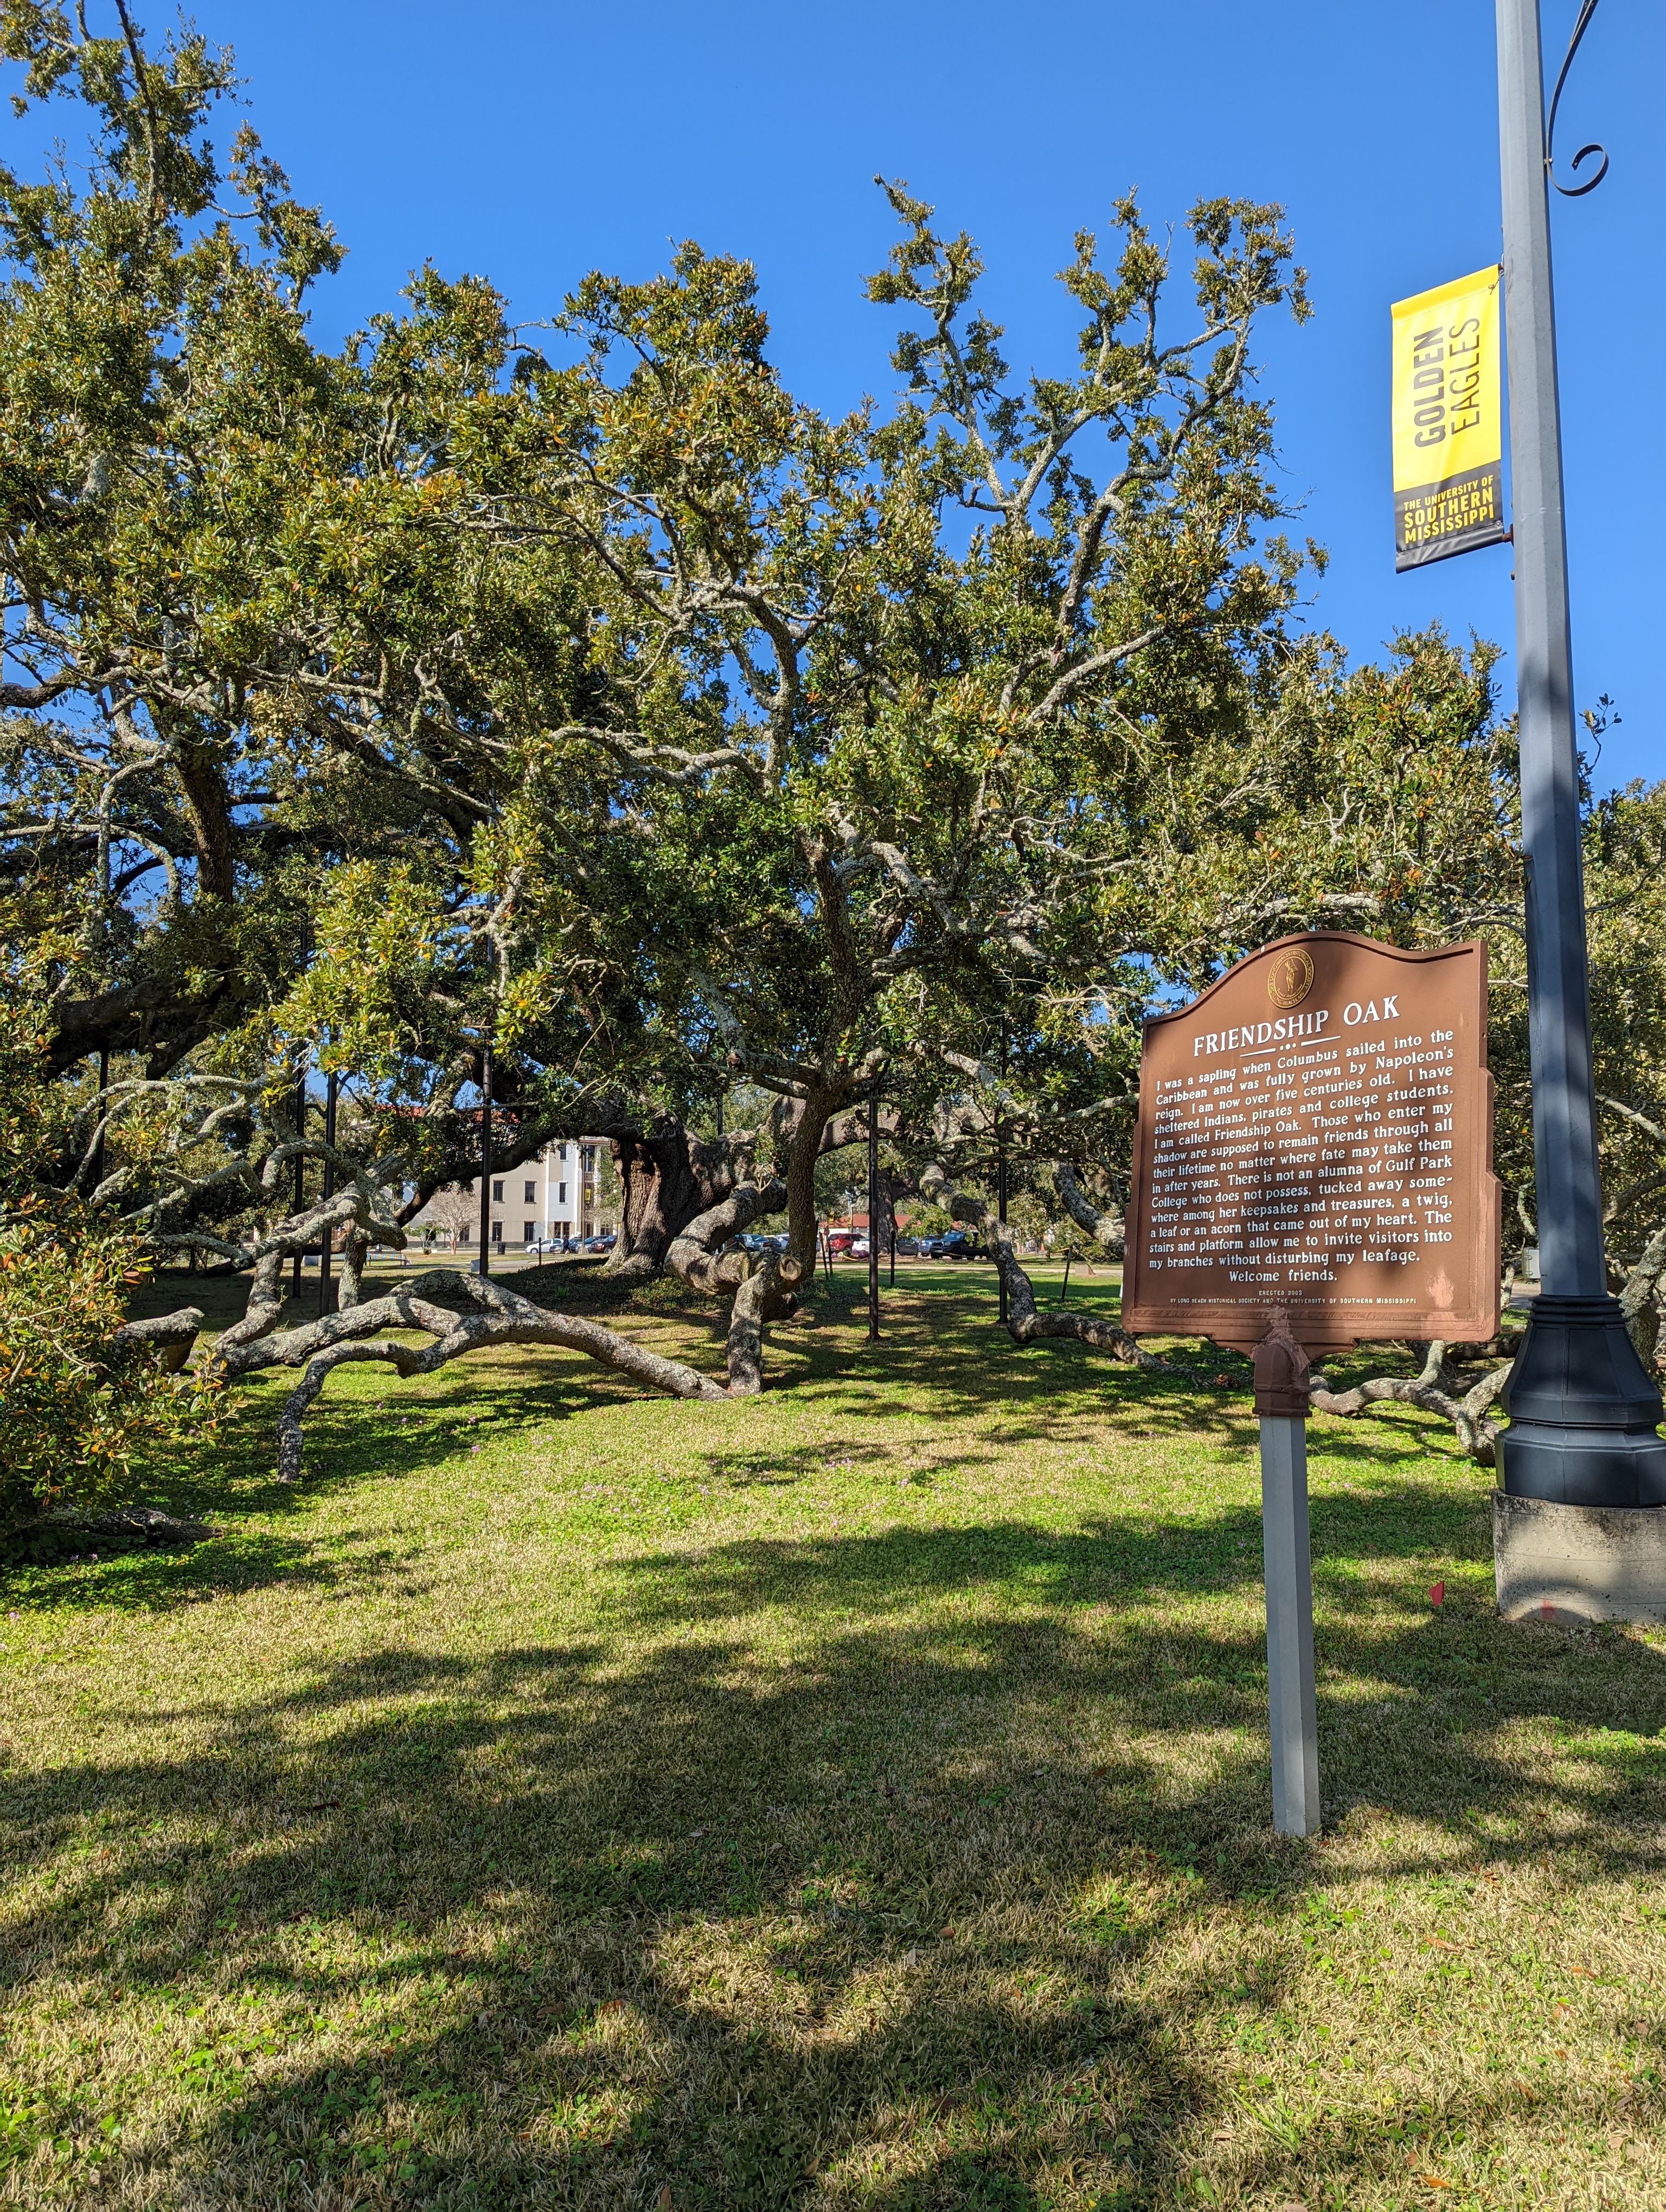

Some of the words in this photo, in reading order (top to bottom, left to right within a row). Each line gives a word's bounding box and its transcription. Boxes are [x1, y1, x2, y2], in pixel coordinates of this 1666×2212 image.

[1413, 326, 1446, 447] GOLDEN
[1449, 318, 1480, 435] EAGLES
[1404, 498, 1421, 511] THE
[1425, 480, 1478, 506] UNIVERSITY
[1481, 474, 1494, 487] OF
[1404, 486, 1493, 529] SOUTHERN
[1405, 504, 1494, 544] MISSISSIPPI
[1270, 965, 1278, 981] LONG
[1194, 1009, 1329, 1057] FRIENDSHIP
[1343, 995, 1400, 1025] OAK
[1156, 1089, 1207, 1105] Caribbean
[1213, 1082, 1233, 1096] and
[1239, 1080, 1259, 1091] was
[1266, 1072, 1295, 1086] fully
[1302, 1066, 1341, 1084] grown
[1349, 1062, 1367, 1075] by
[1375, 1045, 1453, 1069] Napoleon's
[1157, 1081, 1161, 1091] I
[1164, 1079, 1182, 1089] was
[1188, 1077, 1194, 1085] a
[1199, 1068, 1237, 1084] sapling
[1242, 1062, 1271, 1075] when
[1277, 1050, 1338, 1069] Columbus
[1345, 1040, 1386, 1057] sailed
[1394, 1035, 1422, 1049] into
[1430, 1030, 1453, 1043] the
[1154, 1118, 1200, 1135] sheltered
[1204, 1114, 1246, 1127] Indians,
[1252, 1106, 1292, 1123] pirates
[1299, 1100, 1322, 1114] and
[1330, 1094, 1379, 1109] college
[1387, 1083, 1453, 1102] students.
[1155, 1108, 1183, 1121] reign.
[1191, 1103, 1196, 1114] I
[1199, 1103, 1214, 1113] am
[1219, 1098, 1241, 1110] now
[1245, 1094, 1271, 1105] over
[1276, 1089, 1298, 1101] five
[1303, 1079, 1362, 1097] centuries
[1369, 1073, 1395, 1087] old.
[1409, 1069, 1413, 1082] I
[1419, 1066, 1453, 1080] have
[1153, 1152, 1188, 1164] shadow
[1190, 1149, 1207, 1159] are
[1210, 1141, 1259, 1158] supposed
[1263, 1140, 1274, 1150] to
[1278, 1134, 1319, 1149] remain
[1324, 1128, 1368, 1143] friends
[1373, 1121, 1429, 1138] through
[1434, 1117, 1453, 1132] all
[1155, 1139, 1158, 1149] I
[1160, 1139, 1174, 1148] am
[1178, 1131, 1210, 1146] called
[1214, 1123, 1271, 1141] Friendship
[1276, 1119, 1302, 1133] Oak.
[1311, 1115, 1349, 1128] Those
[1354, 1110, 1381, 1123] who
[1388, 1105, 1426, 1119] enter
[1432, 1103, 1453, 1115] my
[1152, 1182, 1161, 1194] in
[1164, 1180, 1188, 1192] after
[1190, 1179, 1221, 1192] years.
[1227, 1174, 1260, 1186] There
[1263, 1171, 1272, 1183] is
[1276, 1169, 1295, 1181] not
[1298, 1169, 1313, 1179] an
[1318, 1165, 1363, 1178] alumna
[1368, 1160, 1382, 1174] of
[1386, 1157, 1415, 1172] Gulf
[1420, 1154, 1453, 1169] Park
[1153, 1167, 1175, 1179] their
[1178, 1162, 1217, 1176] lifetime
[1220, 1161, 1234, 1171] no
[1239, 1156, 1276, 1169] matter
[1280, 1152, 1316, 1165] where
[1321, 1148, 1345, 1161] fate
[1351, 1146, 1379, 1158] may
[1383, 1141, 1413, 1155] take
[1418, 1139, 1452, 1152] them
[1151, 1197, 1188, 1210] College
[1191, 1193, 1212, 1204] who
[1215, 1192, 1239, 1203] does
[1244, 1188, 1263, 1200] not
[1266, 1186, 1311, 1201] possess,
[1318, 1180, 1362, 1194] tucked
[1368, 1179, 1404, 1192] away
[1409, 1176, 1453, 1188] some-
[1151, 1212, 1179, 1223] where
[1183, 1210, 1215, 1223] among
[1219, 1207, 1238, 1218] her
[1240, 1202, 1299, 1218] keepsakes
[1303, 1199, 1327, 1212] and
[1330, 1198, 1395, 1211] treasures,
[1402, 1198, 1410, 1207] a
[1416, 1192, 1452, 1208] twig,
[1149, 1242, 1175, 1253] stairs
[1177, 1240, 1195, 1252] and
[1199, 1238, 1244, 1253] platform
[1249, 1236, 1279, 1249] allow
[1283, 1237, 1300, 1247] me
[1305, 1234, 1318, 1246] to
[1324, 1232, 1362, 1245] invite
[1368, 1231, 1419, 1244] visitors
[1424, 1229, 1452, 1243] into
[1150, 1230, 1156, 1238] a
[1159, 1225, 1177, 1238] leaf
[1180, 1227, 1191, 1236] or
[1194, 1226, 1207, 1236] an
[1211, 1224, 1241, 1234] acorn
[1246, 1220, 1270, 1232] that
[1273, 1220, 1304, 1231] came
[1309, 1217, 1330, 1229] out
[1334, 1214, 1348, 1227] of
[1351, 1217, 1372, 1229] my
[1376, 1212, 1417, 1226] heart.
[1424, 1210, 1452, 1224] The
[1149, 1260, 1163, 1270] my
[1167, 1256, 1213, 1268] branches
[1219, 1253, 1261, 1266] without
[1265, 1251, 1329, 1266] disturbing
[1336, 1253, 1355, 1265] my
[1362, 1248, 1420, 1265] leafage.
[1229, 1270, 1280, 1282] Welcome
[1288, 1269, 1337, 1281] friends.
